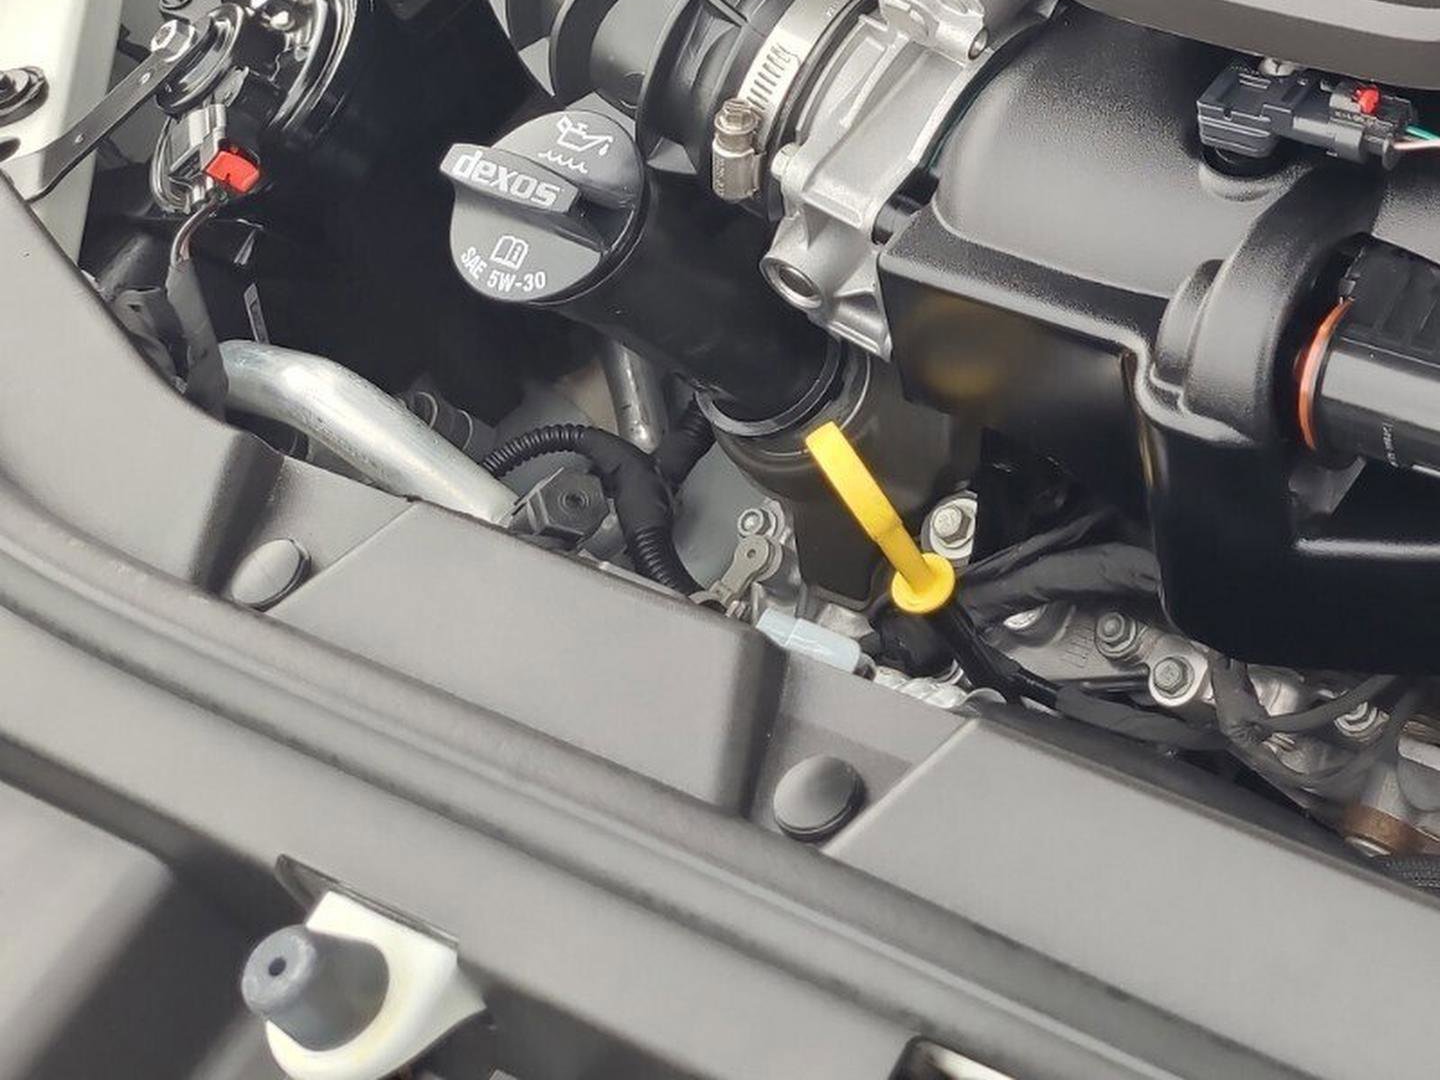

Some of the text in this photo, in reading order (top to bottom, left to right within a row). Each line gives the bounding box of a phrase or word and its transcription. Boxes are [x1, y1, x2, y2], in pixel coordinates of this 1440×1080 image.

[453, 150, 560, 206] dexos
[461, 246, 546, 292] SAE 5W-30
